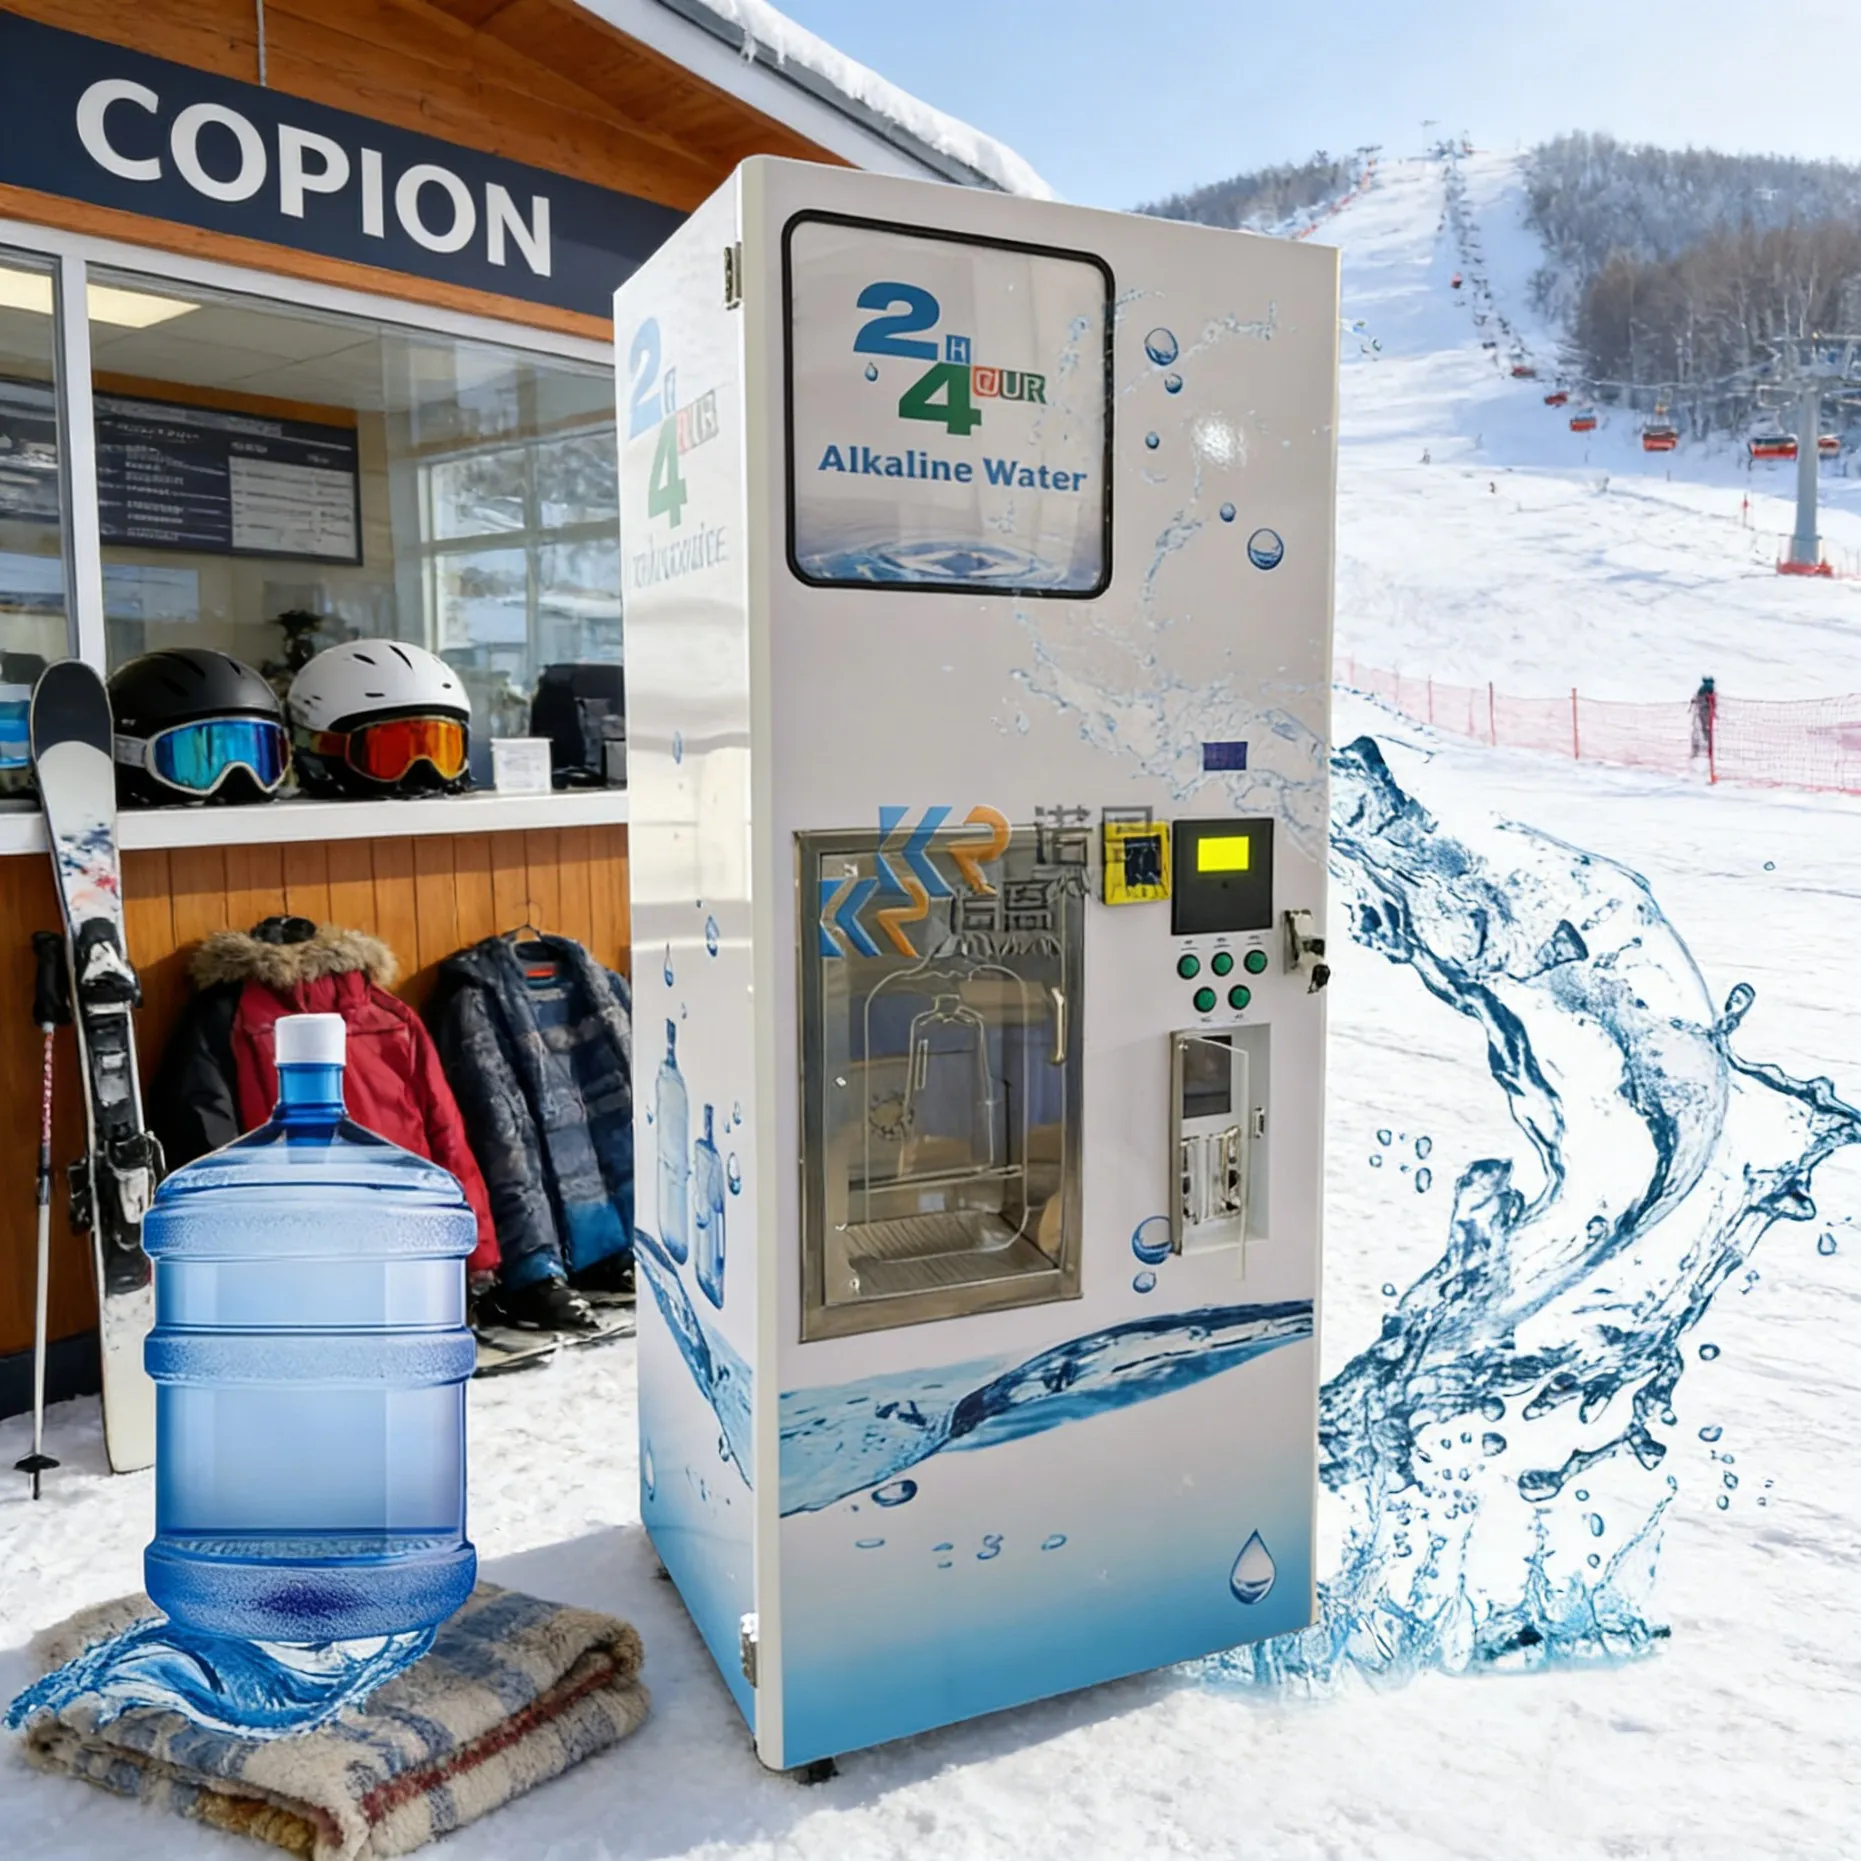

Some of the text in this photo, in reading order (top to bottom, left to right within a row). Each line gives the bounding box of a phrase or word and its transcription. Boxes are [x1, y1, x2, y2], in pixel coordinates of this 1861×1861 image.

[76, 78, 551, 278] COPION
[818, 444, 1088, 492] Alkaline Water
